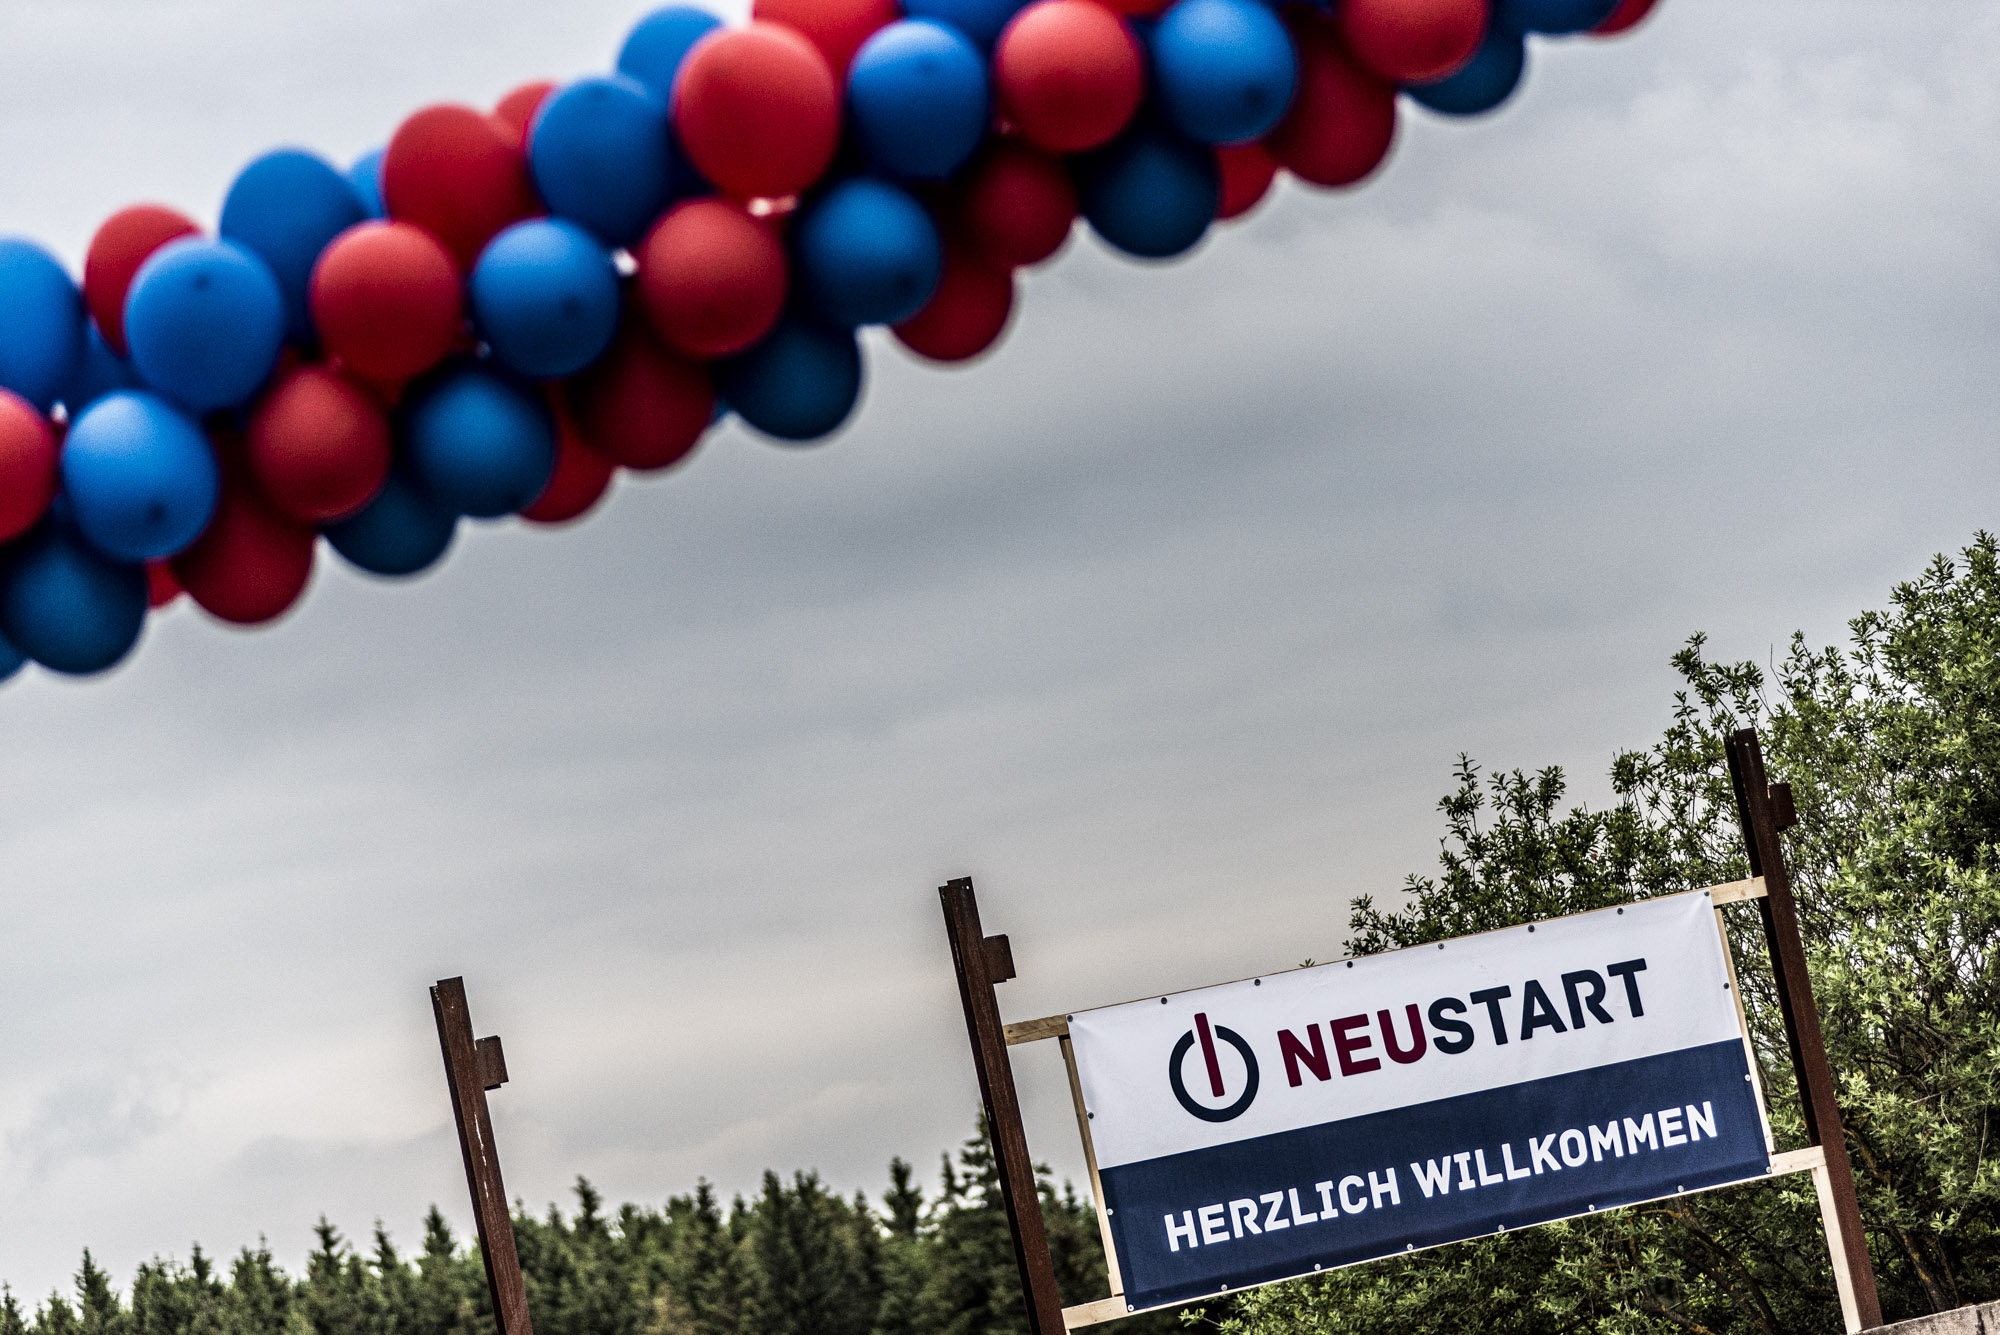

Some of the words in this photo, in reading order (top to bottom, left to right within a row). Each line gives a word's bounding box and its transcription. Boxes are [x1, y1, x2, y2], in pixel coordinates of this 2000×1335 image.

[1277, 958, 1647, 1087] NEUSTART
[1164, 1167, 1400, 1252] HERZLICH
[1411, 1101, 1717, 1199] WILLKOMMEN
